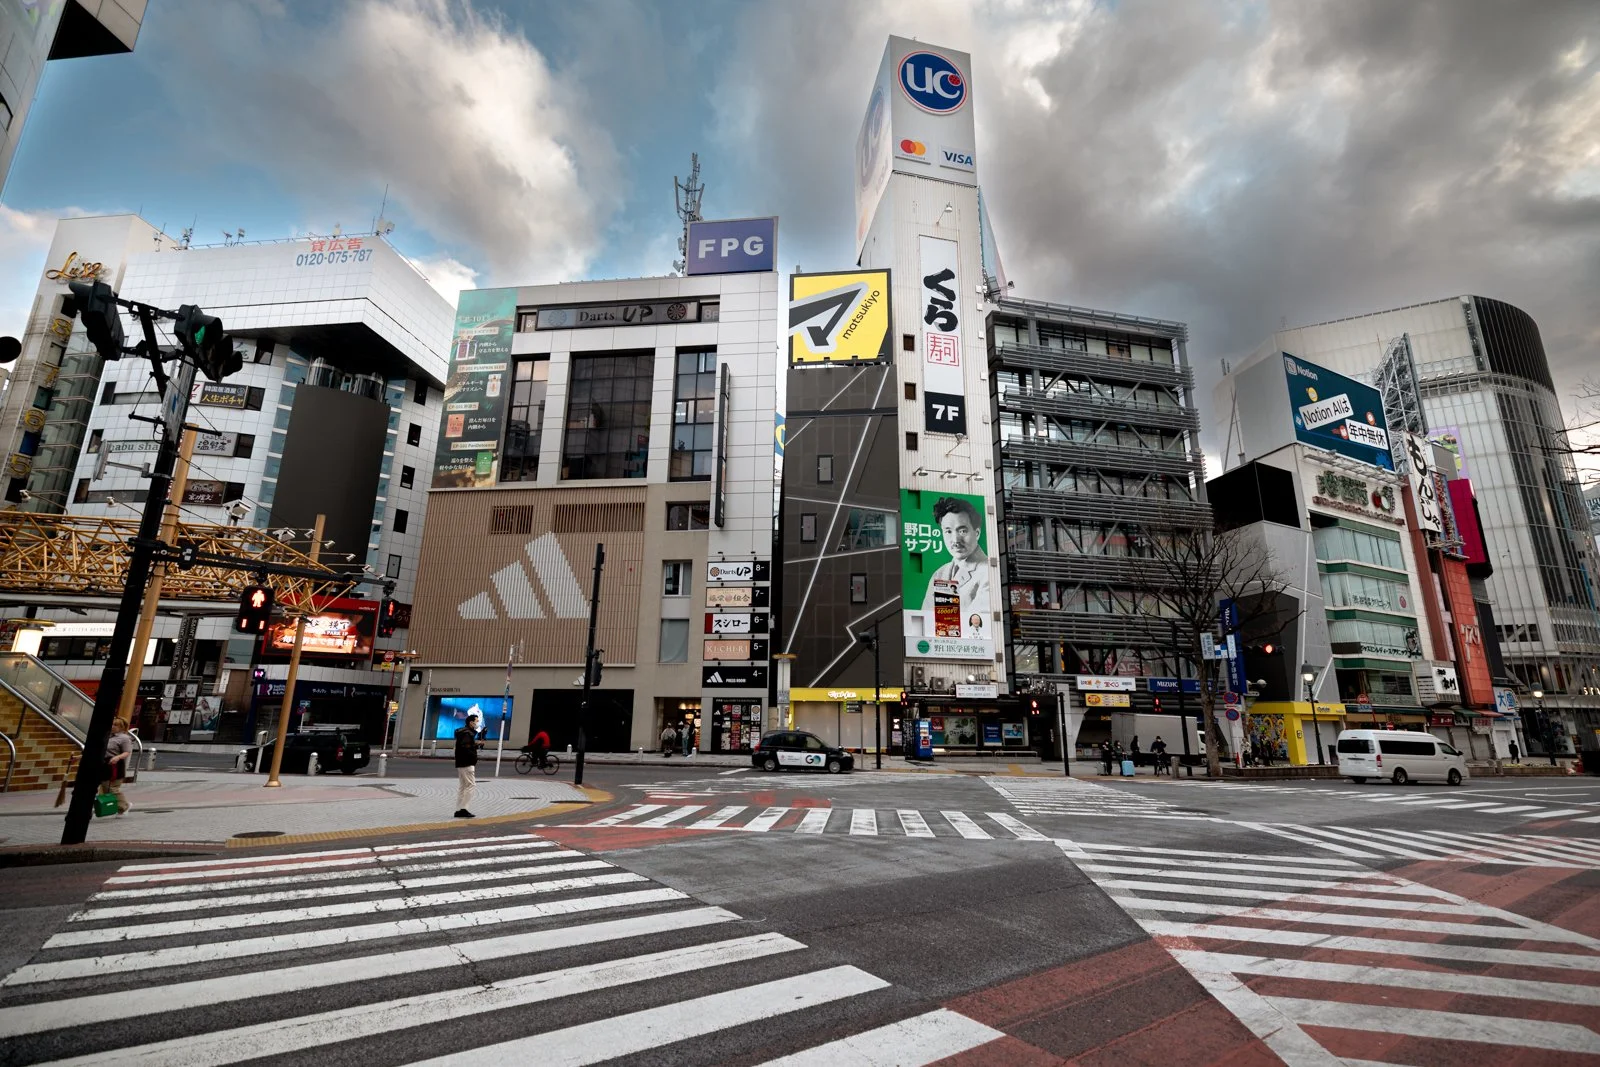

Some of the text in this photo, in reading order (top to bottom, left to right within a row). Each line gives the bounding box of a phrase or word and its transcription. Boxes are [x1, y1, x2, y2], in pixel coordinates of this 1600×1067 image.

[942, 150, 973, 166] VISA
[311, 238, 364, 253] 貸広告
[698, 235, 764, 259] FPG
[296, 249, 373, 266] 0120-075-787
[923, 267, 959, 332] くら
[579, 305, 653, 322] Darts UP
[842, 289, 880, 340] matsukiyo
[52, 318, 71, 338] 8
[1297, 364, 1318, 381] Notion
[24, 408, 46, 431] 6
[932, 403, 959, 421] 7F
[1302, 406, 1333, 425] Notion
[1348, 422, 1386, 447] 年中無休
[904, 522, 941, 538] 野口の
[904, 538, 943, 553] サプリ
[713, 619, 748, 628] スシロー
[934, 644, 985, 653] 野口医学研究所
[805, 754, 821, 764] GO
